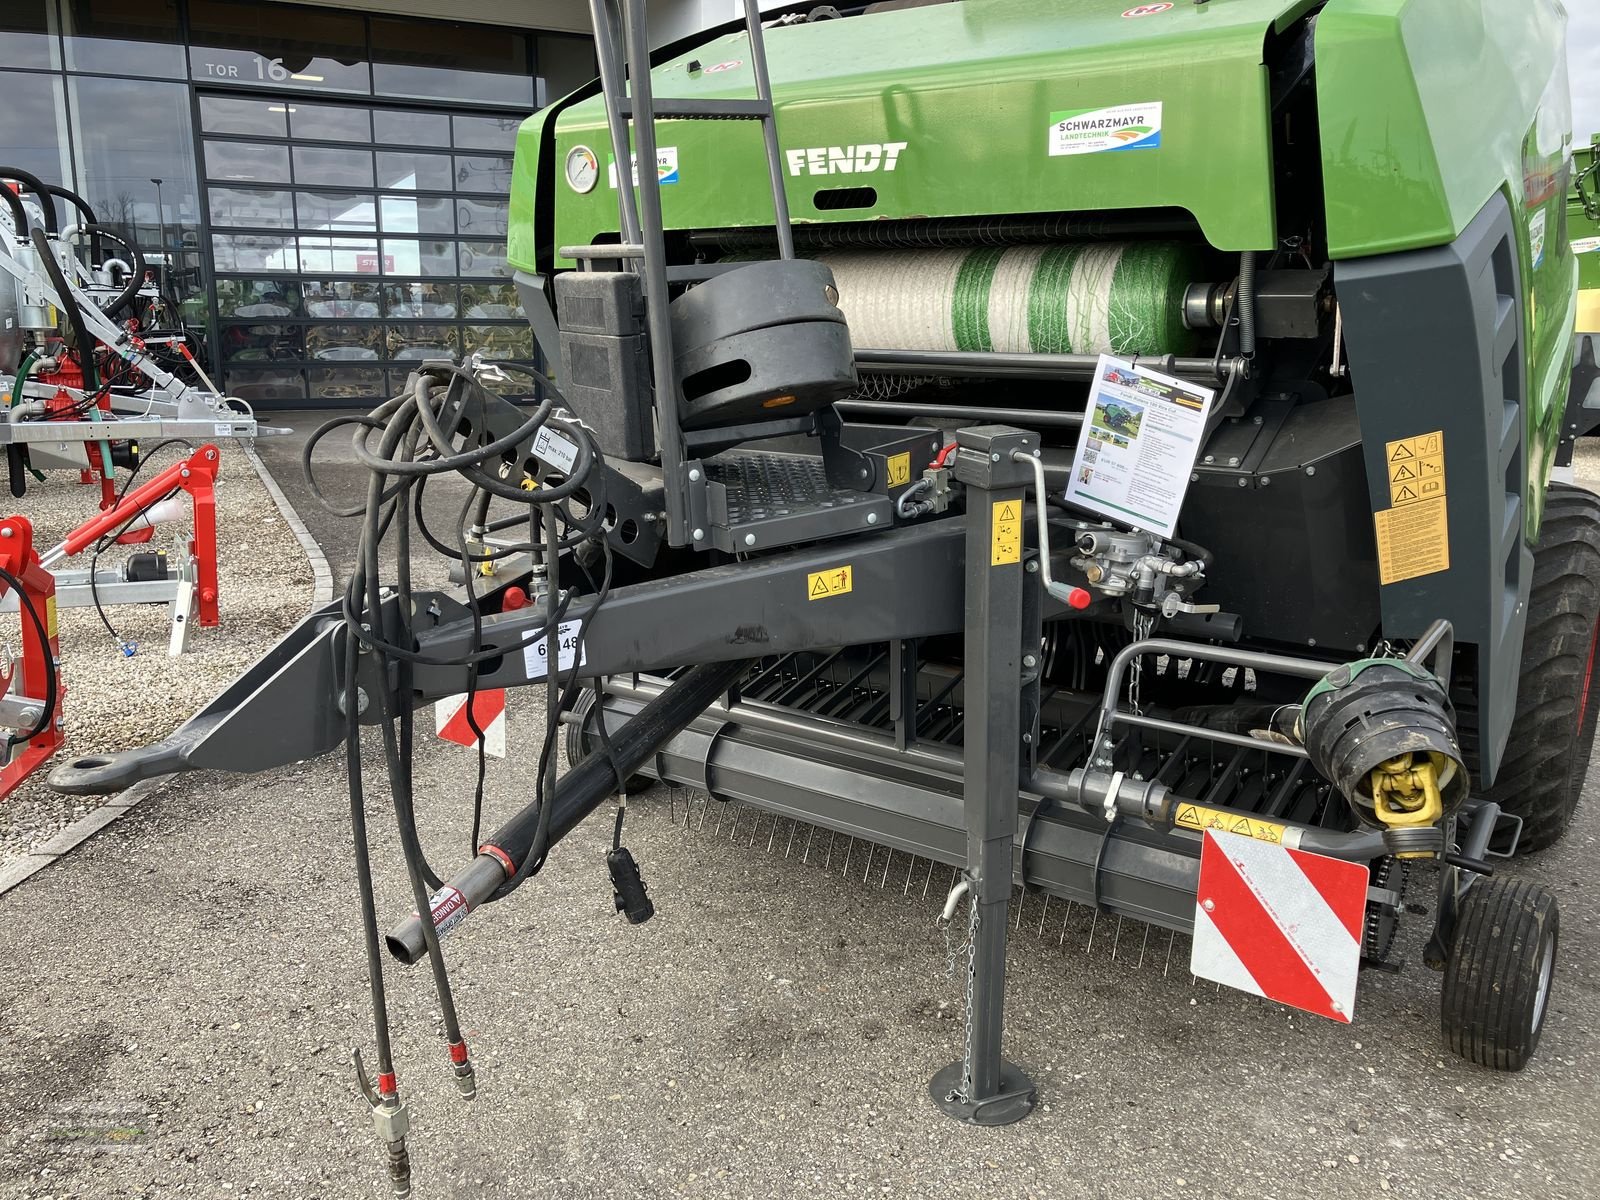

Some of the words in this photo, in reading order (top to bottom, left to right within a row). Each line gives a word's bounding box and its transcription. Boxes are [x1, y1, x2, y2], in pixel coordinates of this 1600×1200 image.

[205, 63, 238, 77] TOR
[253, 56, 287, 81] 16
[1059, 116, 1144, 131] SCHWARZMAYR
[1060, 130, 1110, 141] LANDTECHNIK
[785, 142, 908, 177] FENDT
